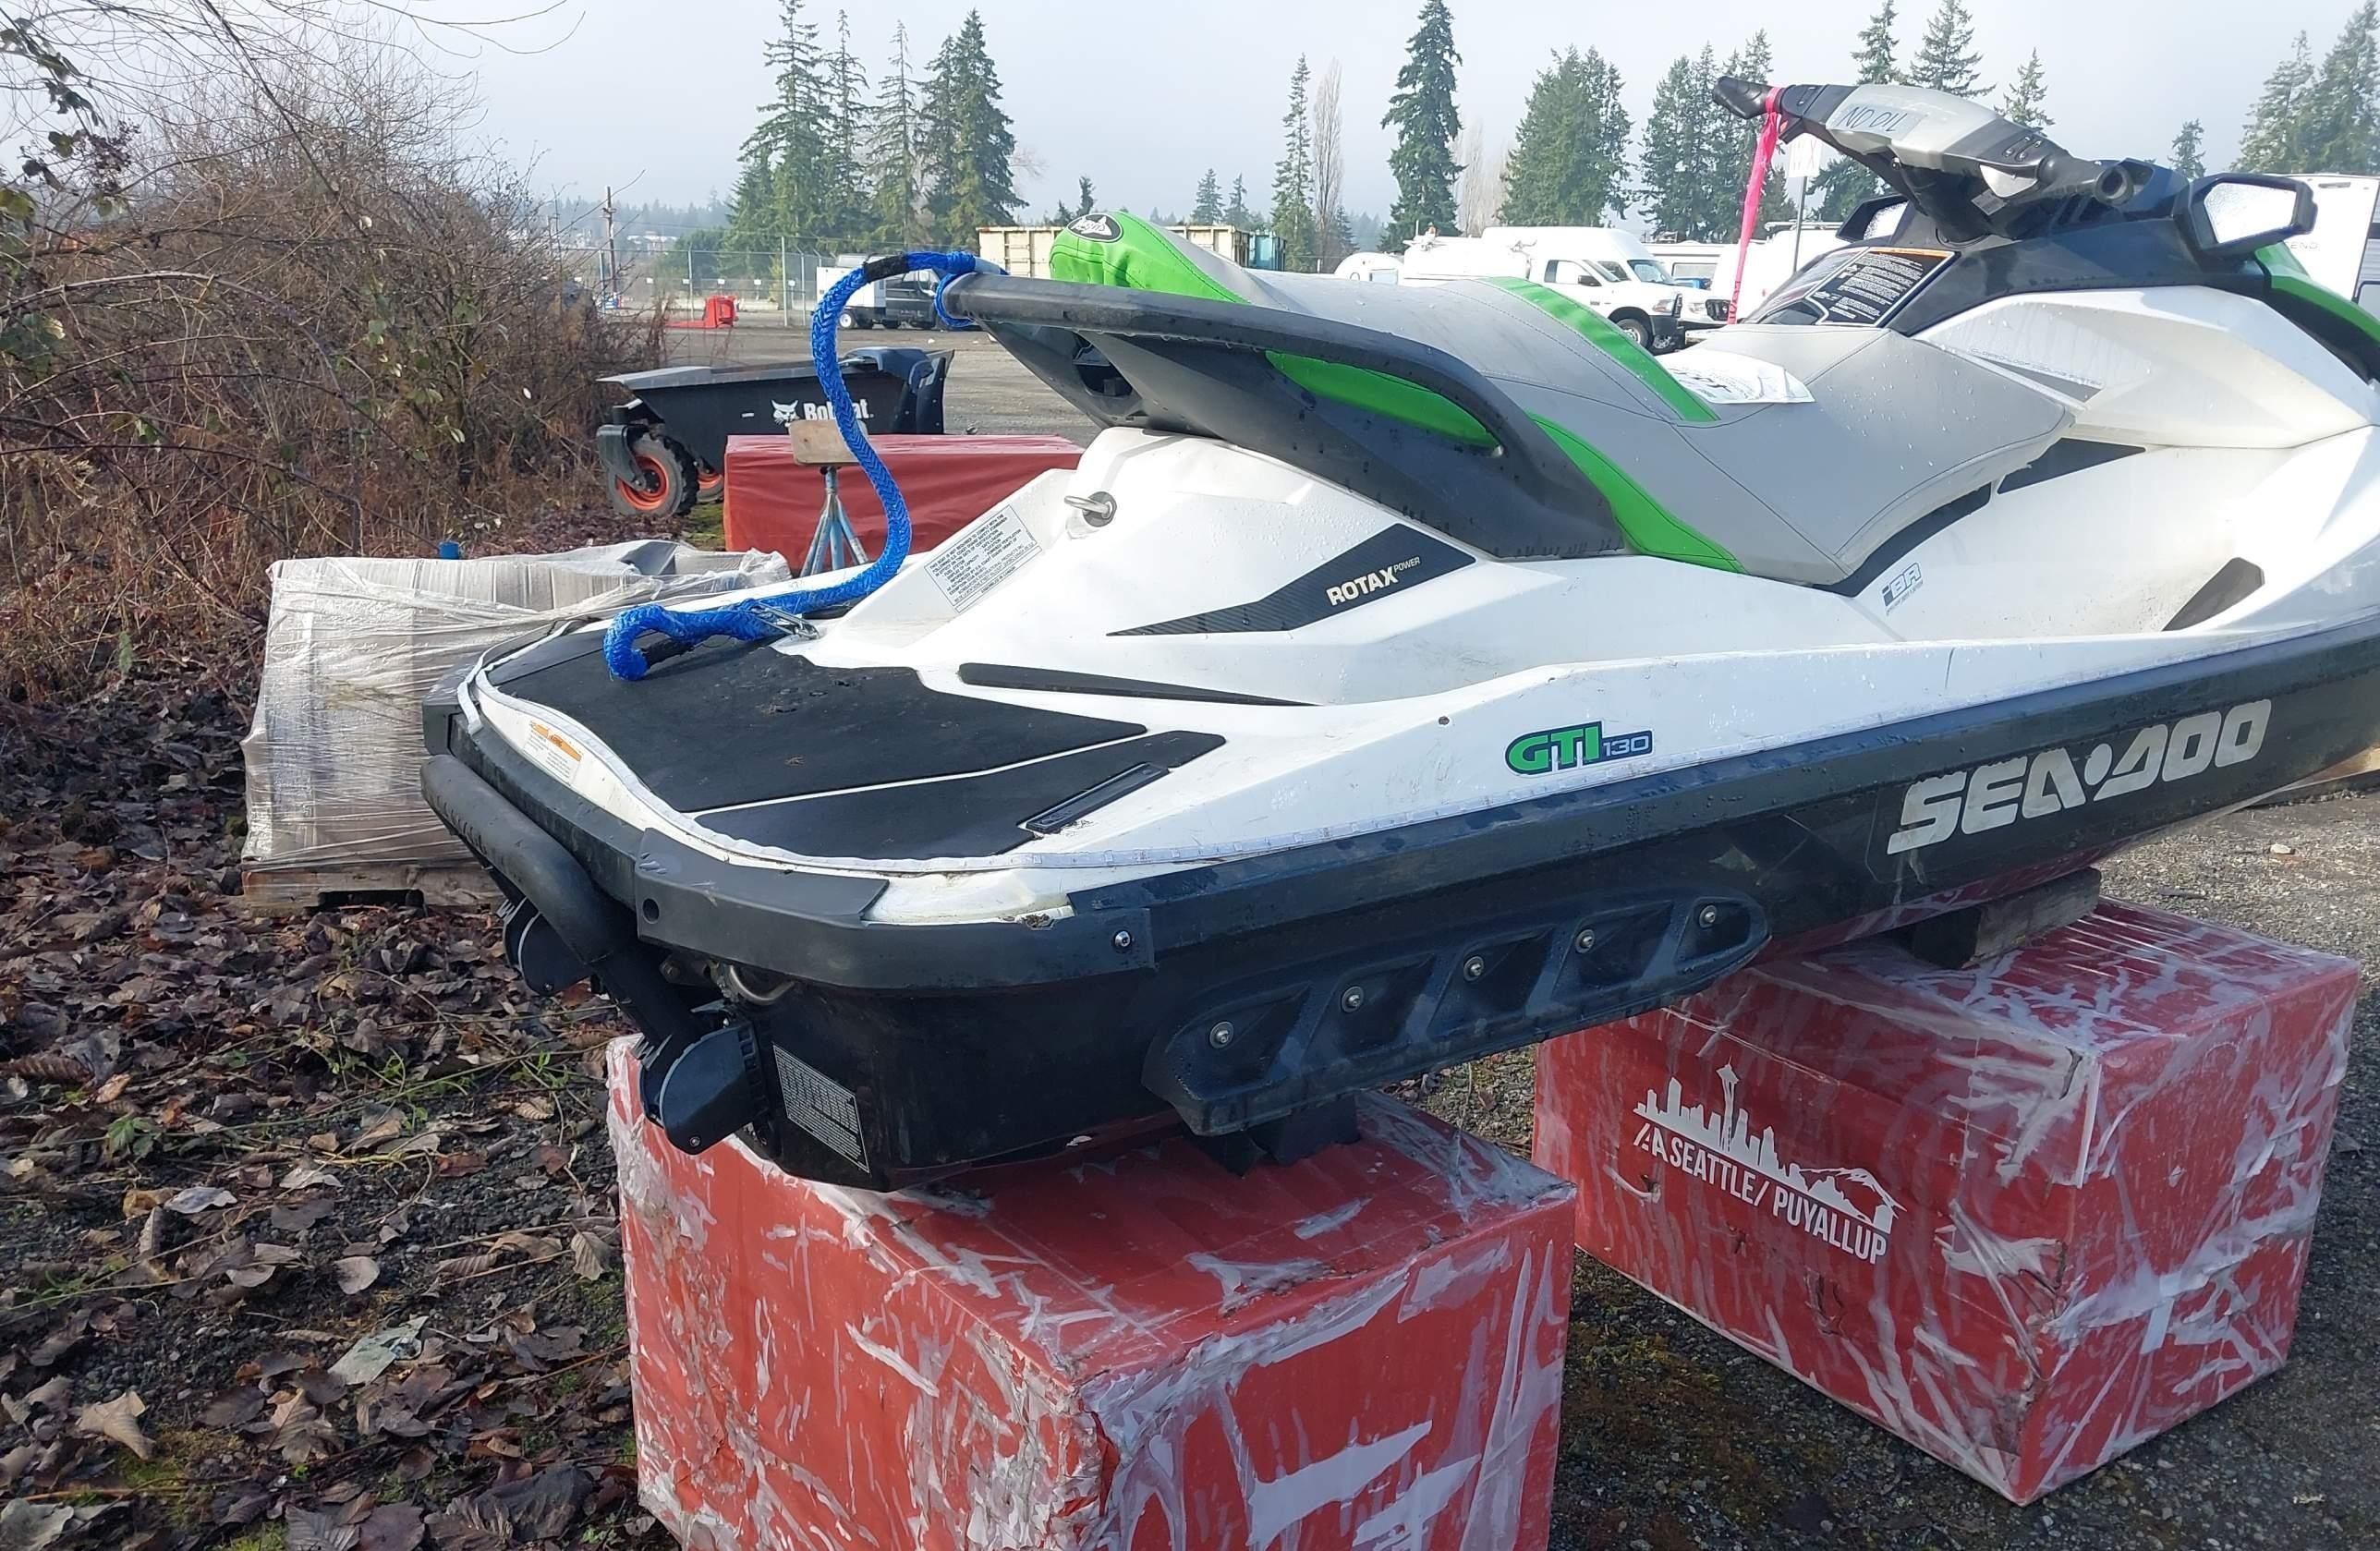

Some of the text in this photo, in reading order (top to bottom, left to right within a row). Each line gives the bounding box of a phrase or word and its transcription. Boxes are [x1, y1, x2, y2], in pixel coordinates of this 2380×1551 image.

[1836, 106, 1908, 131] NO OIL
[802, 398, 869, 421] Bobat
[1326, 556, 1421, 606] ROTAX POWER
[1507, 723, 1650, 771] GTI 130
[1771, 1185, 1888, 1266] PUYALLUP
